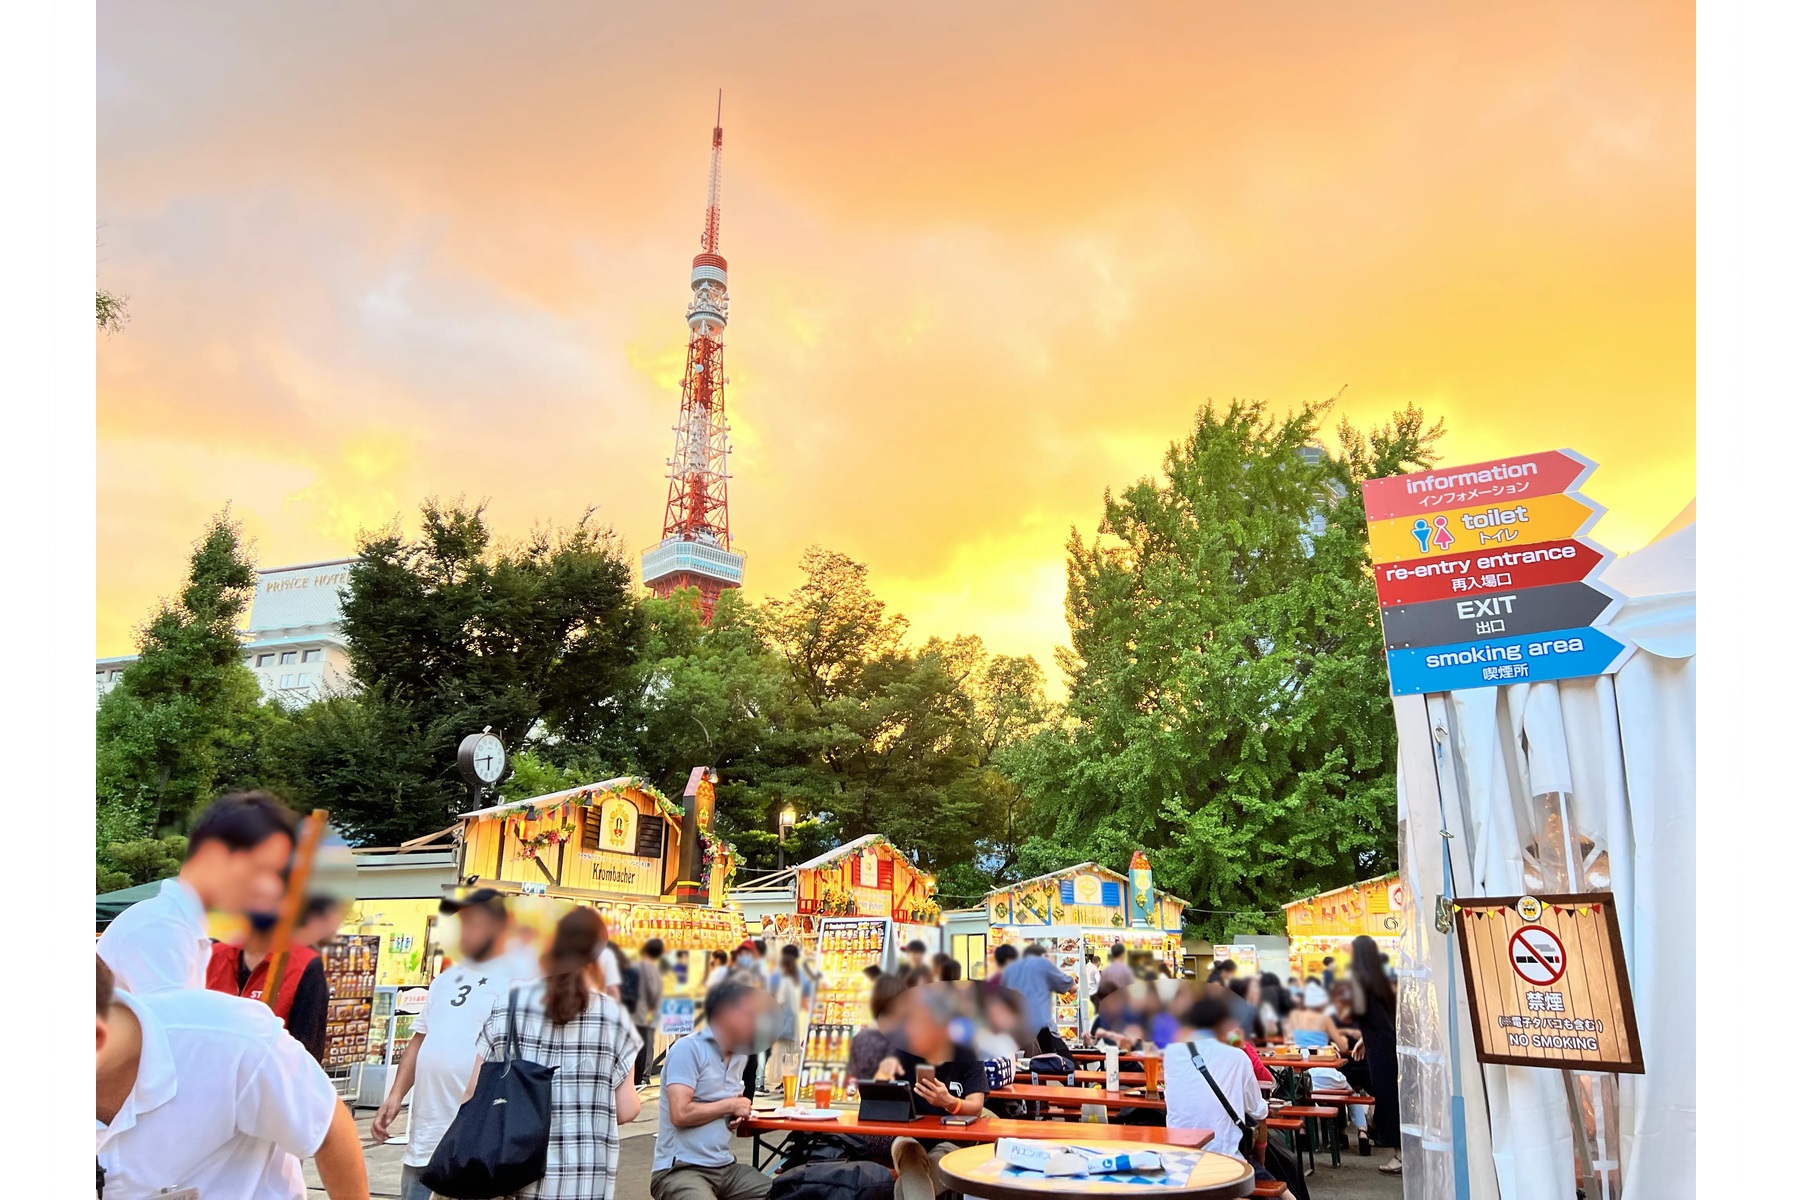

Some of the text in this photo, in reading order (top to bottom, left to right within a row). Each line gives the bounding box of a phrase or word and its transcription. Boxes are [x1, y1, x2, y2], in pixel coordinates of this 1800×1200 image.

[1406, 460, 1537, 494] information
[1418, 481, 1530, 507] インフォメーション
[1461, 505, 1529, 530] toilet
[1479, 529, 1519, 544] トイレ
[1386, 544, 1576, 582] re-entry entrance
[266, 576, 309, 593] PRINCE
[1451, 572, 1512, 592] 再入場口
[1456, 595, 1517, 619] EXIT
[1476, 620, 1505, 635] 出口
[1426, 637, 1583, 668] smoking area
[1482, 664, 1529, 681] 喫煙所
[592, 863, 636, 884] Krombacher
[450, 985, 472, 1007] 3
[1525, 991, 1566, 1012] 禁煙
[1509, 1034, 1598, 1051] NO SMOKING
